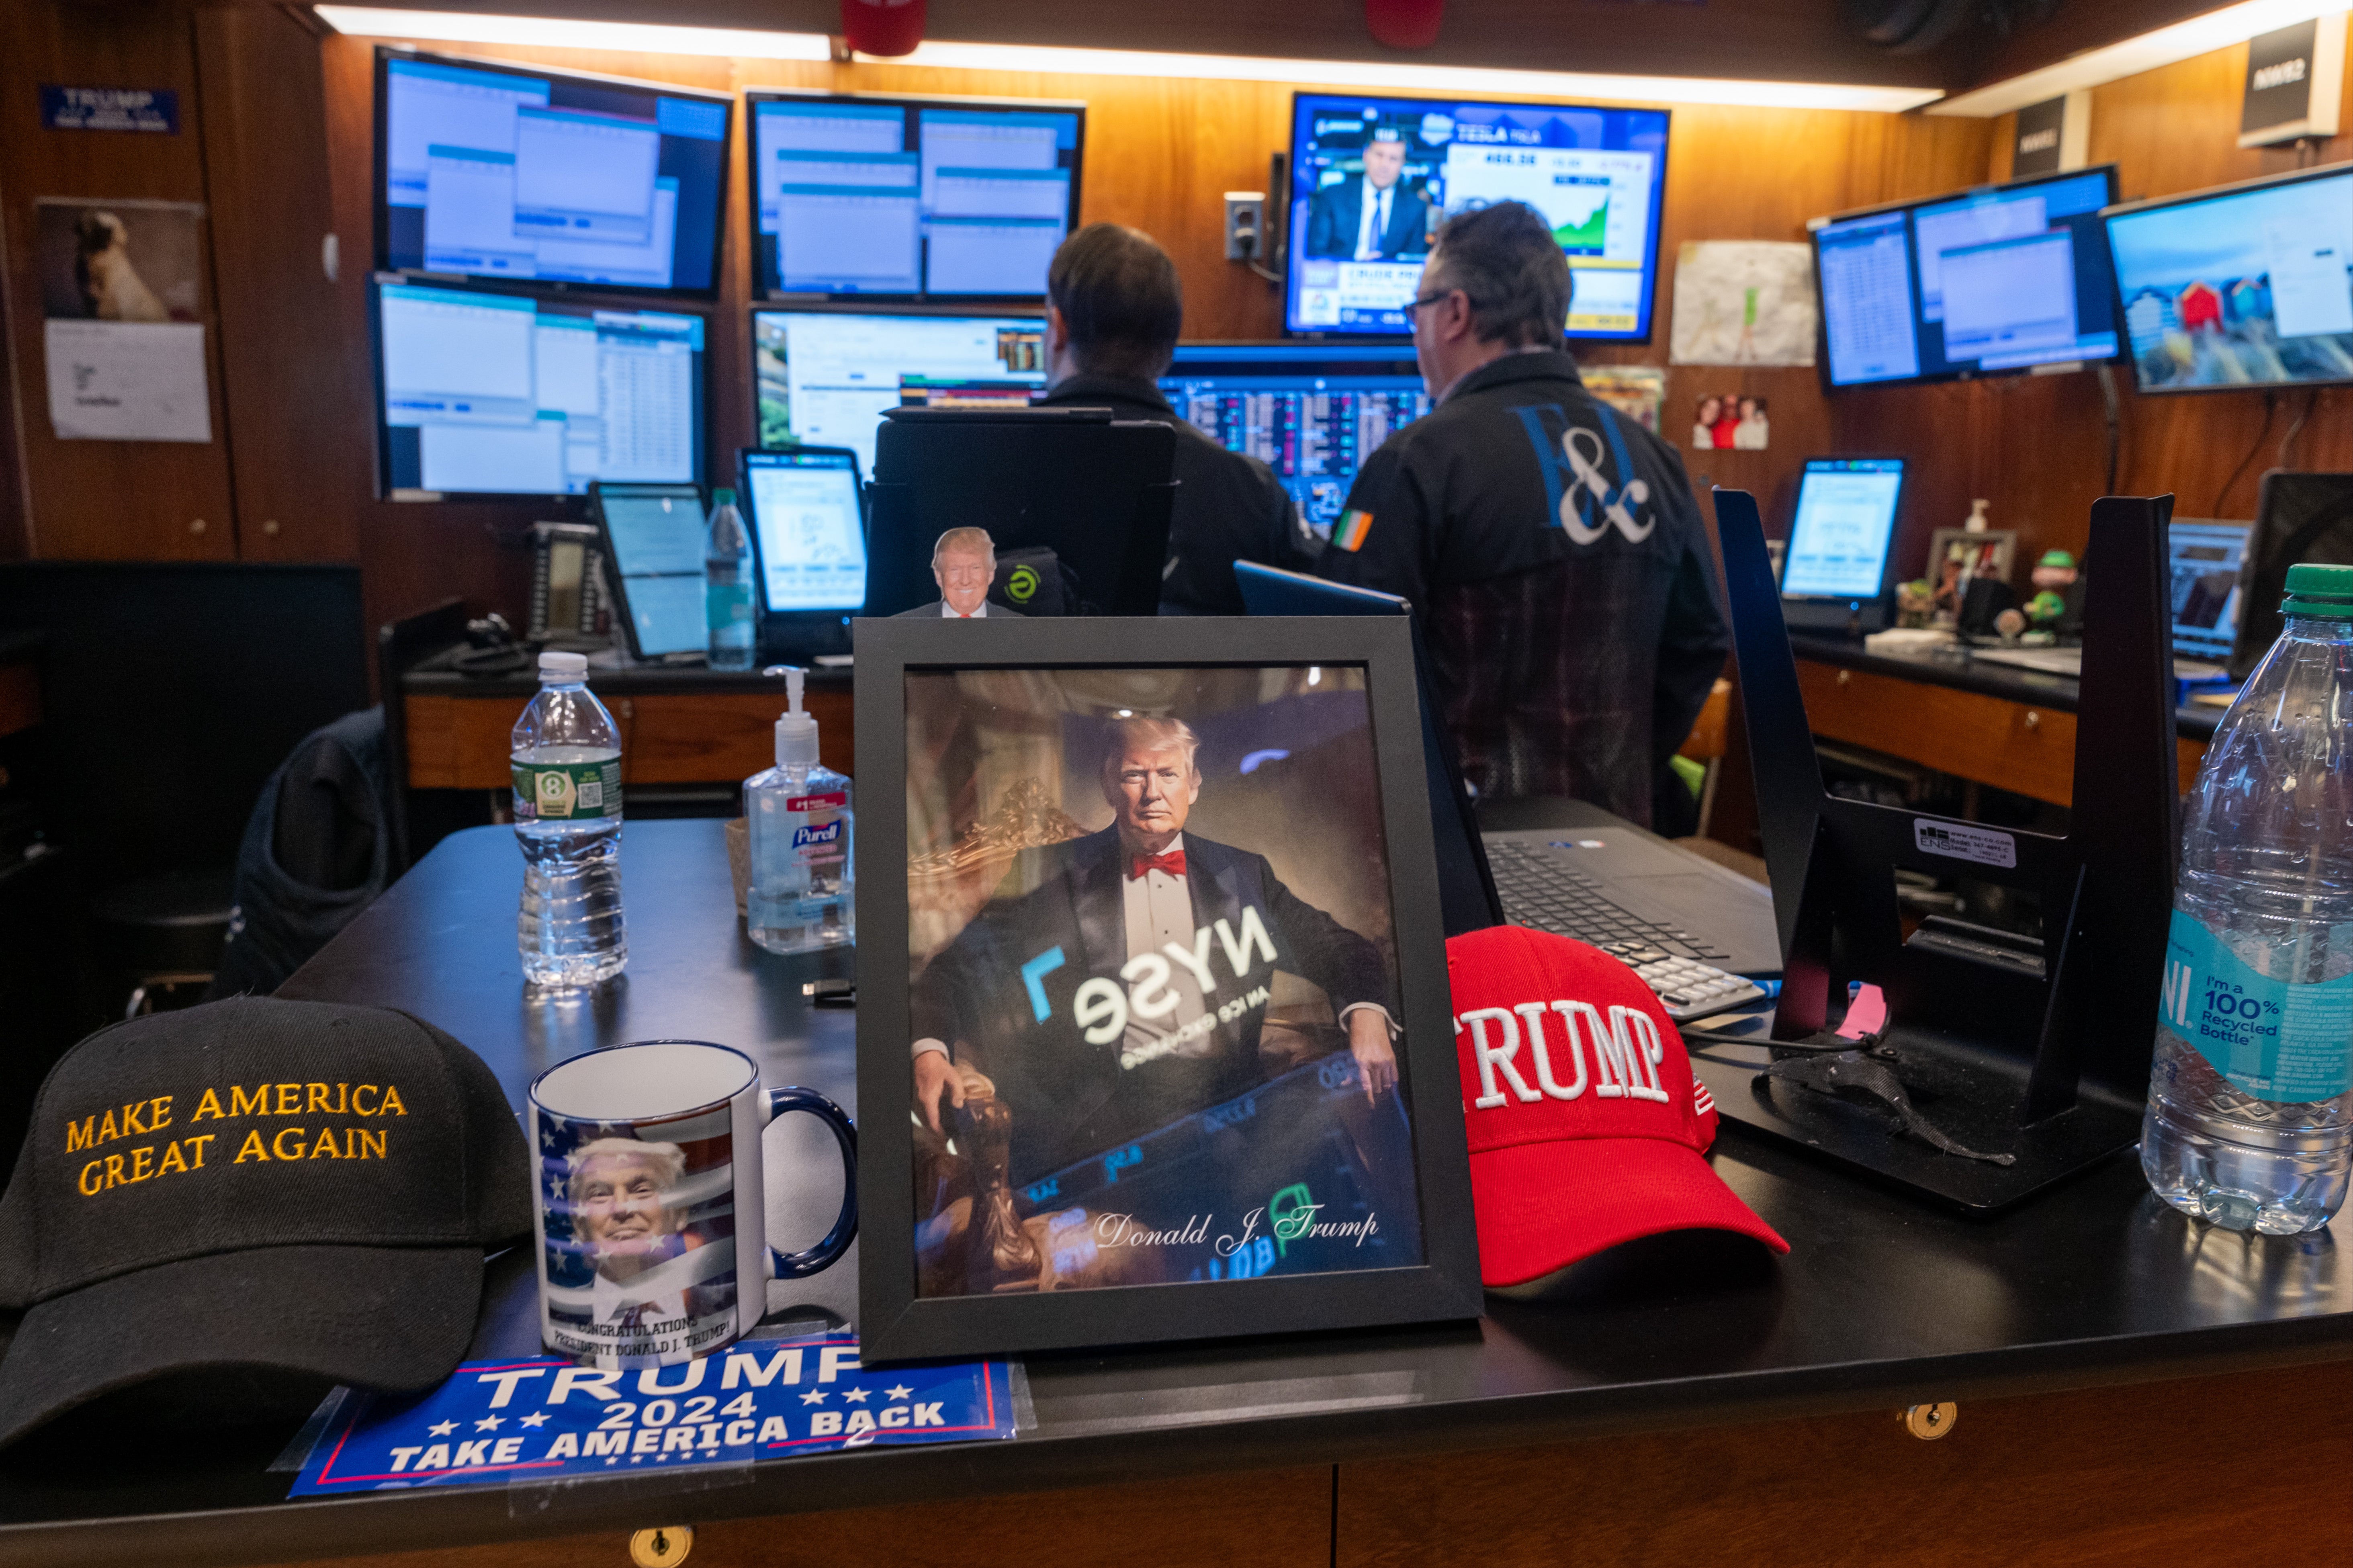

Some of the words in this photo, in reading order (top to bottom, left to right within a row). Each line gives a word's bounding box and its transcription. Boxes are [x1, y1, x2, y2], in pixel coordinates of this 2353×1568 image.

[798, 824, 837, 844] Purell
[1920, 836, 1951, 851] ENS
[2205, 991, 2279, 1020] 100%
[2233, 984, 2243, 995] a
[2202, 1010, 2277, 1036] Recycled
[1453, 999, 1669, 1109] RUMP
[65, 1095, 174, 1155] MAKE
[190, 1082, 408, 1124] AMERICA
[78, 1134, 216, 1197] GREAT
[233, 1127, 387, 1165] AGAIN
[1093, 1213, 1213, 1249] Donald
[1215, 1206, 1265, 1257] J.
[1274, 1203, 1379, 1247] Trump
[554, 1330, 612, 1356] PRESIDENT
[615, 1341, 670, 1357] DONALD
[673, 1337, 681, 1353] J.
[684, 1320, 730, 1348] TRUMP!
[477, 1346, 861, 1409] TRUMP
[597, 1391, 757, 1431] 2024
[389, 1436, 525, 1472] TAKE
[544, 1415, 788, 1460] AMERICA
[810, 1401, 945, 1437] BACK
